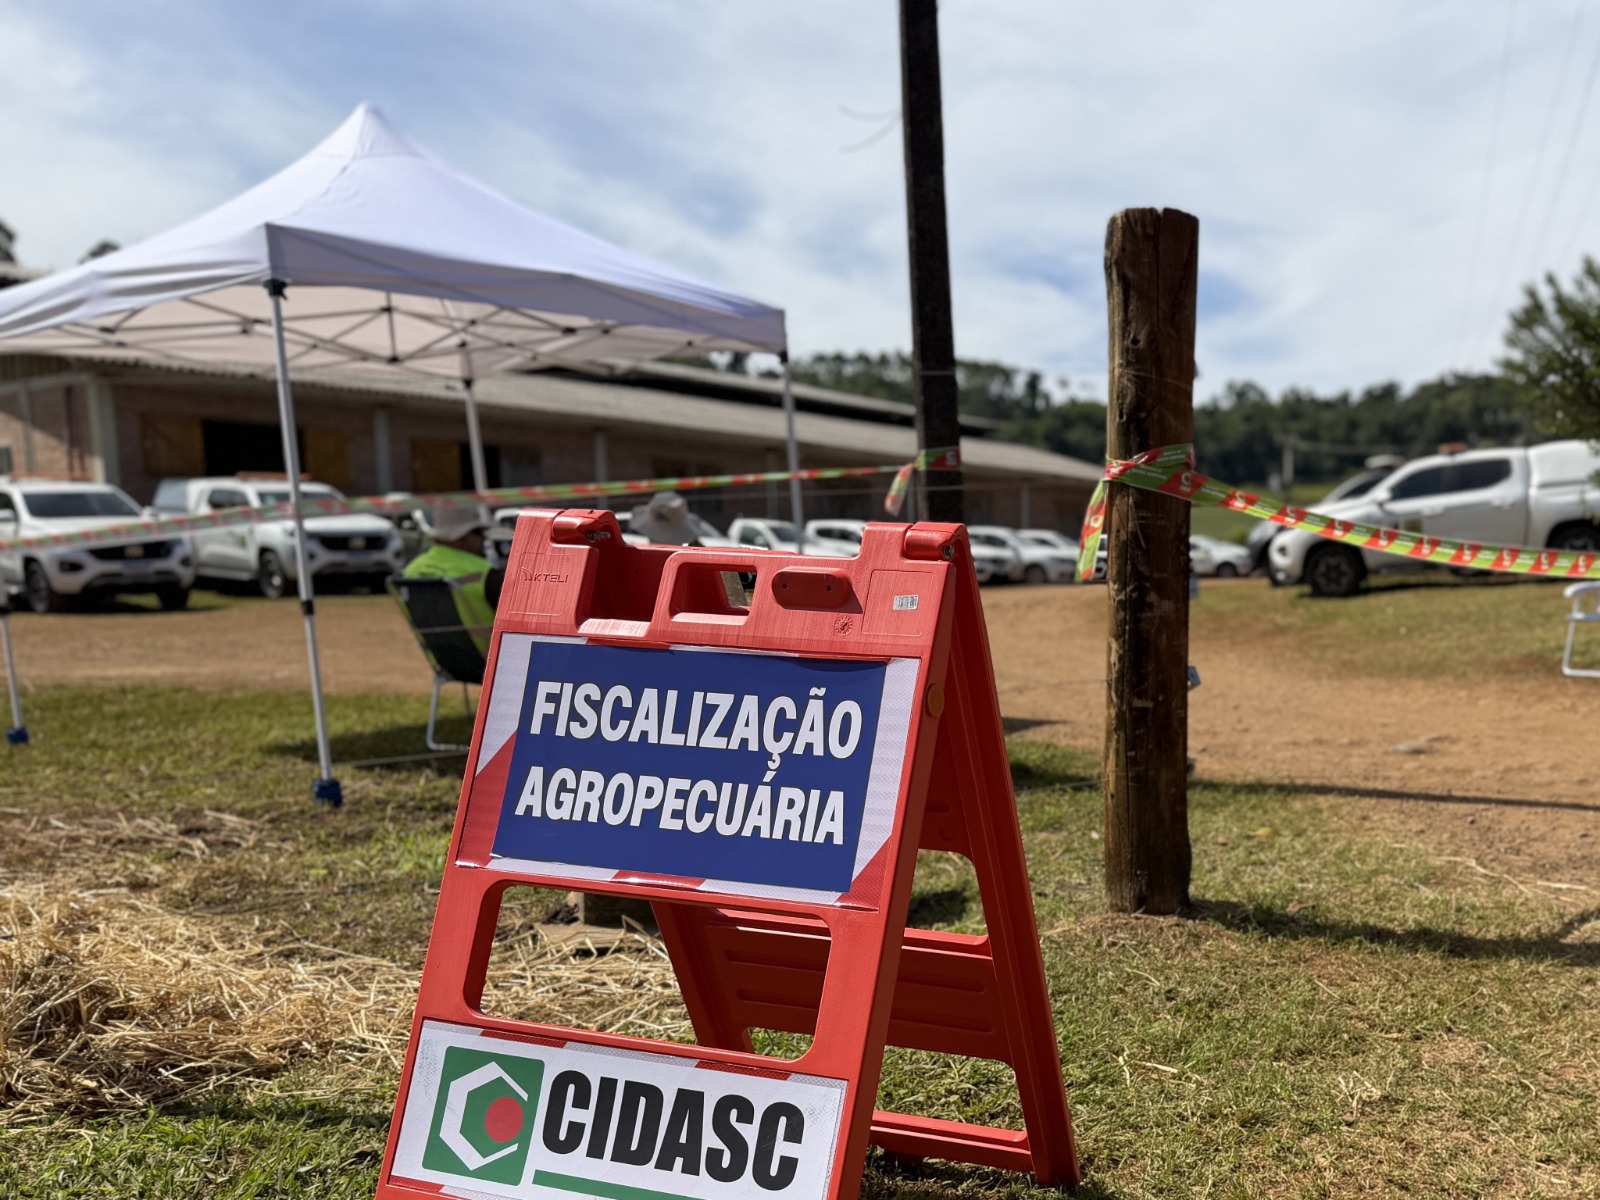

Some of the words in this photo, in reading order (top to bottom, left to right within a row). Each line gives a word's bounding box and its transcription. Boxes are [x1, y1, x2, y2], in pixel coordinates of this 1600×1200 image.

[530, 681, 863, 769] FISCALIZAÇÃO
[514, 766, 845, 844] AGROPECUÁRIA
[542, 1069, 804, 1191] CIDASC
